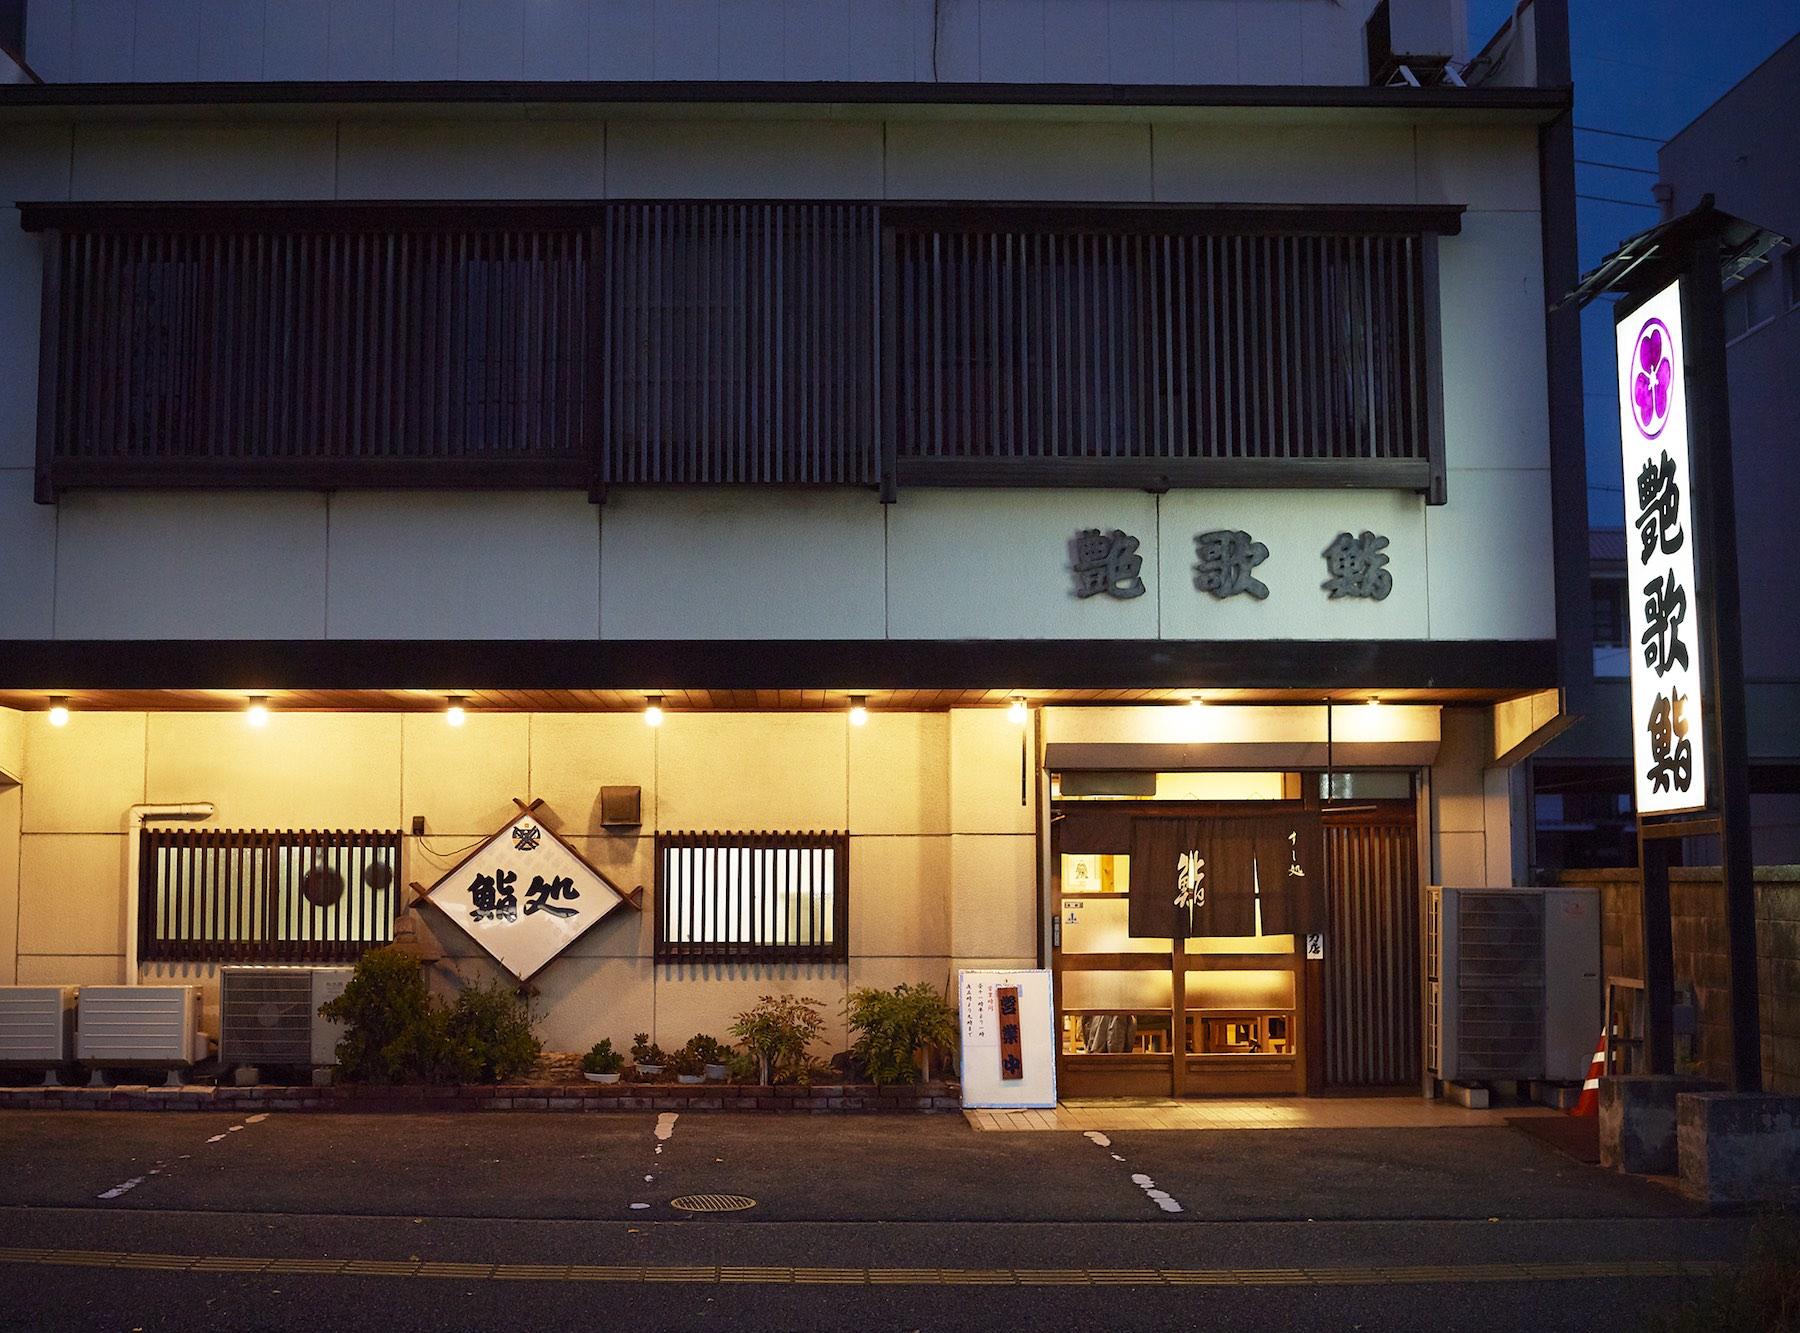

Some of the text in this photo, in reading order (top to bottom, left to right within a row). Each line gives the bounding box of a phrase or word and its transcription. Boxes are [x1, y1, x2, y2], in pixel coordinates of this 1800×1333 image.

[1635, 449, 1692, 794] 艶歌鮨
[467, 868, 581, 923] 鮨処
[1001, 996, 1019, 1074] 営業中
